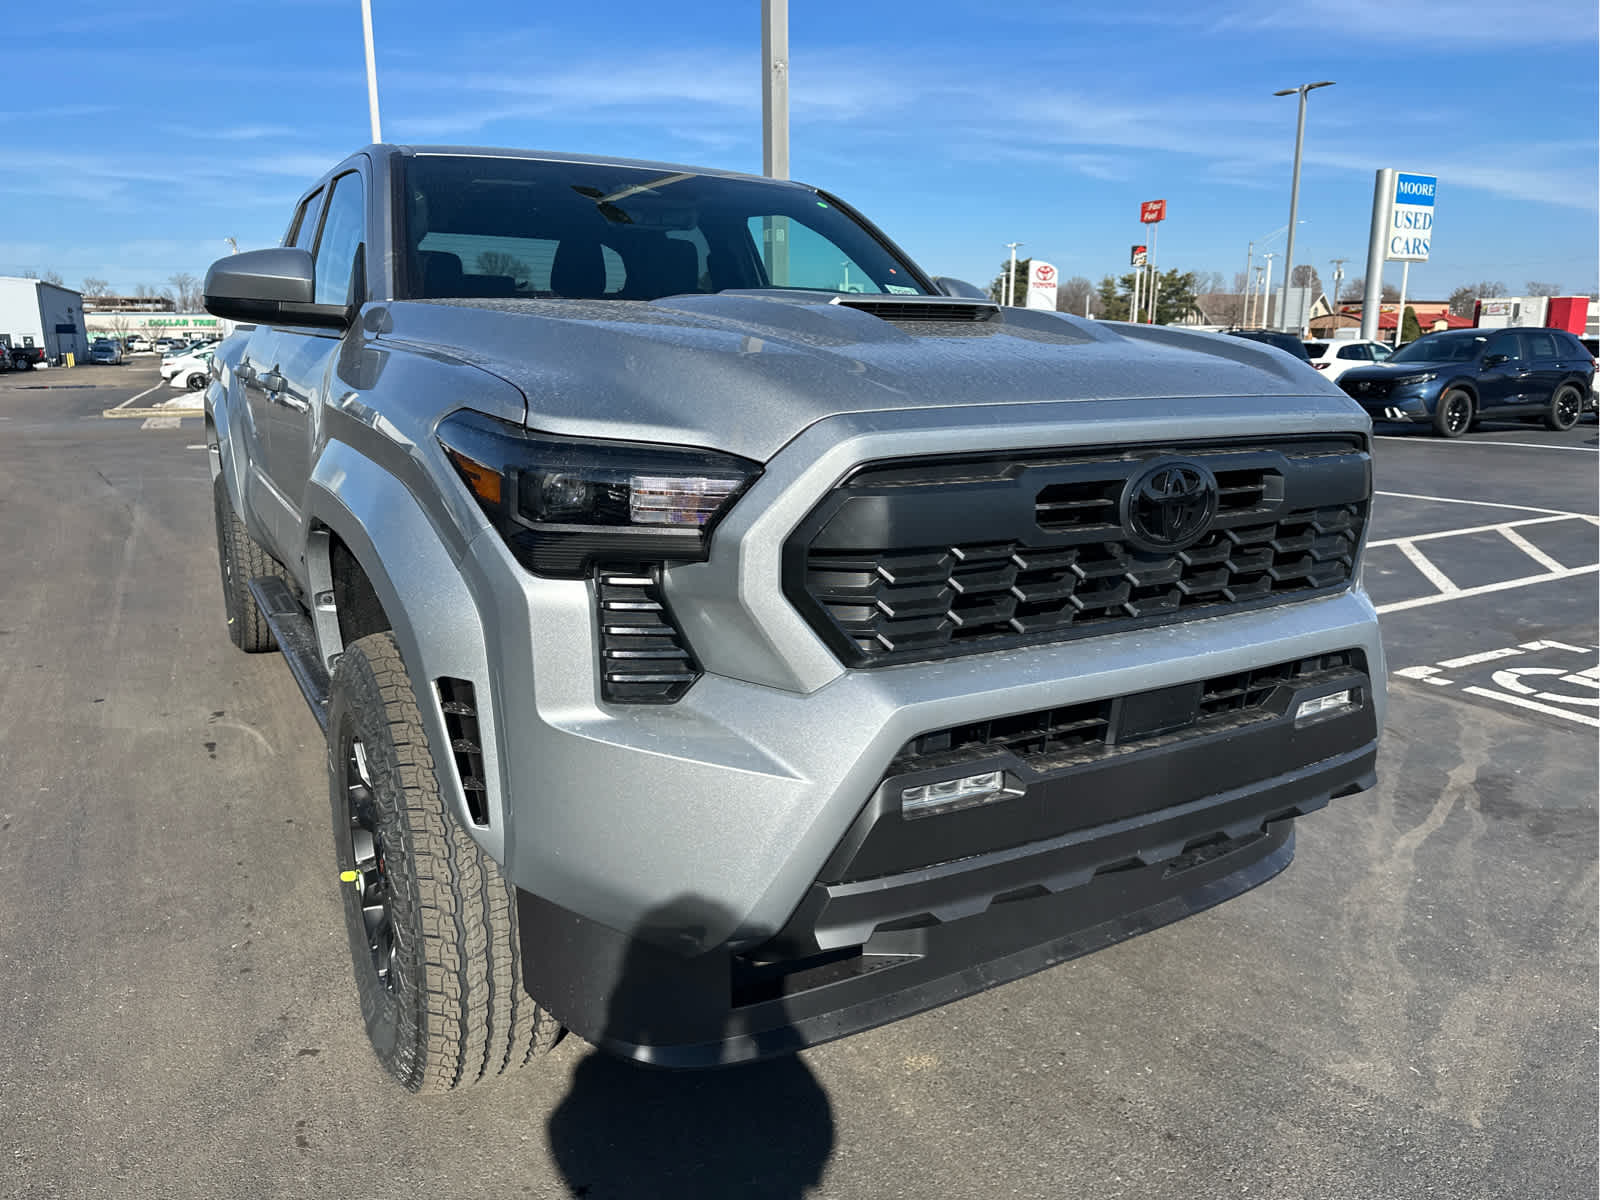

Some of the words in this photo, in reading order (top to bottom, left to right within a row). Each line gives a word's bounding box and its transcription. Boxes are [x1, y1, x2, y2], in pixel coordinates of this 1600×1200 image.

[1399, 181, 1434, 196] MOORE
[1394, 210, 1432, 230] USED
[1391, 236, 1429, 255] CARS
[148, 319, 189, 327] DOLLAR
[192, 319, 217, 327] TREE
